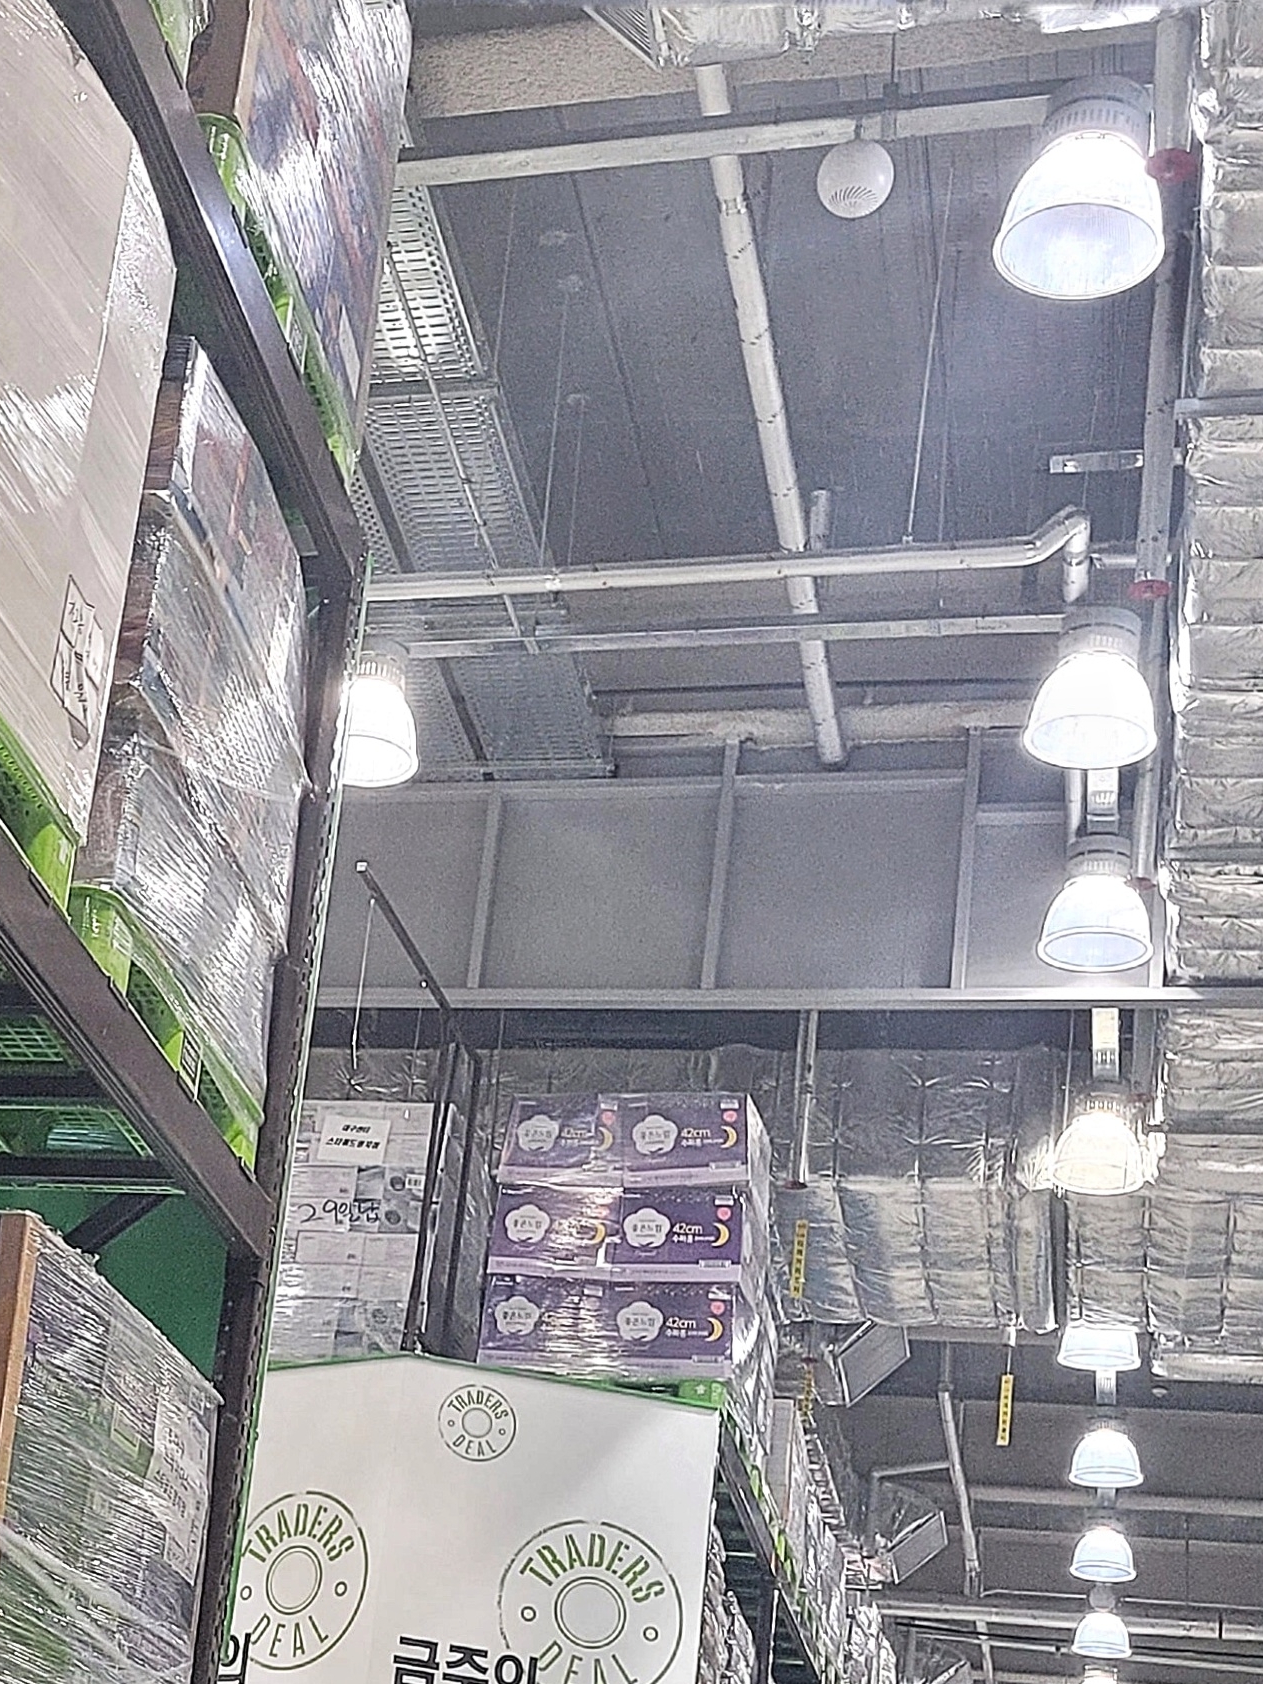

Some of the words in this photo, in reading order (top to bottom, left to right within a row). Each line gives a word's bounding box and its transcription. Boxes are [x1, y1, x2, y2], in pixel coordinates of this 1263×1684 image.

[561, 1128, 587, 1138] 42cm
[681, 1128, 711, 1138] 42cm
[672, 1224, 703, 1234] 42cm
[666, 1318, 696, 1329] 42cm
[447, 1389, 509, 1421] TRADERS
[452, 1433, 498, 1457] DEAL
[241, 1502, 355, 1564] TRADERS
[520, 1532, 666, 1605] TRADERS
[248, 1613, 330, 1659] DEAL
